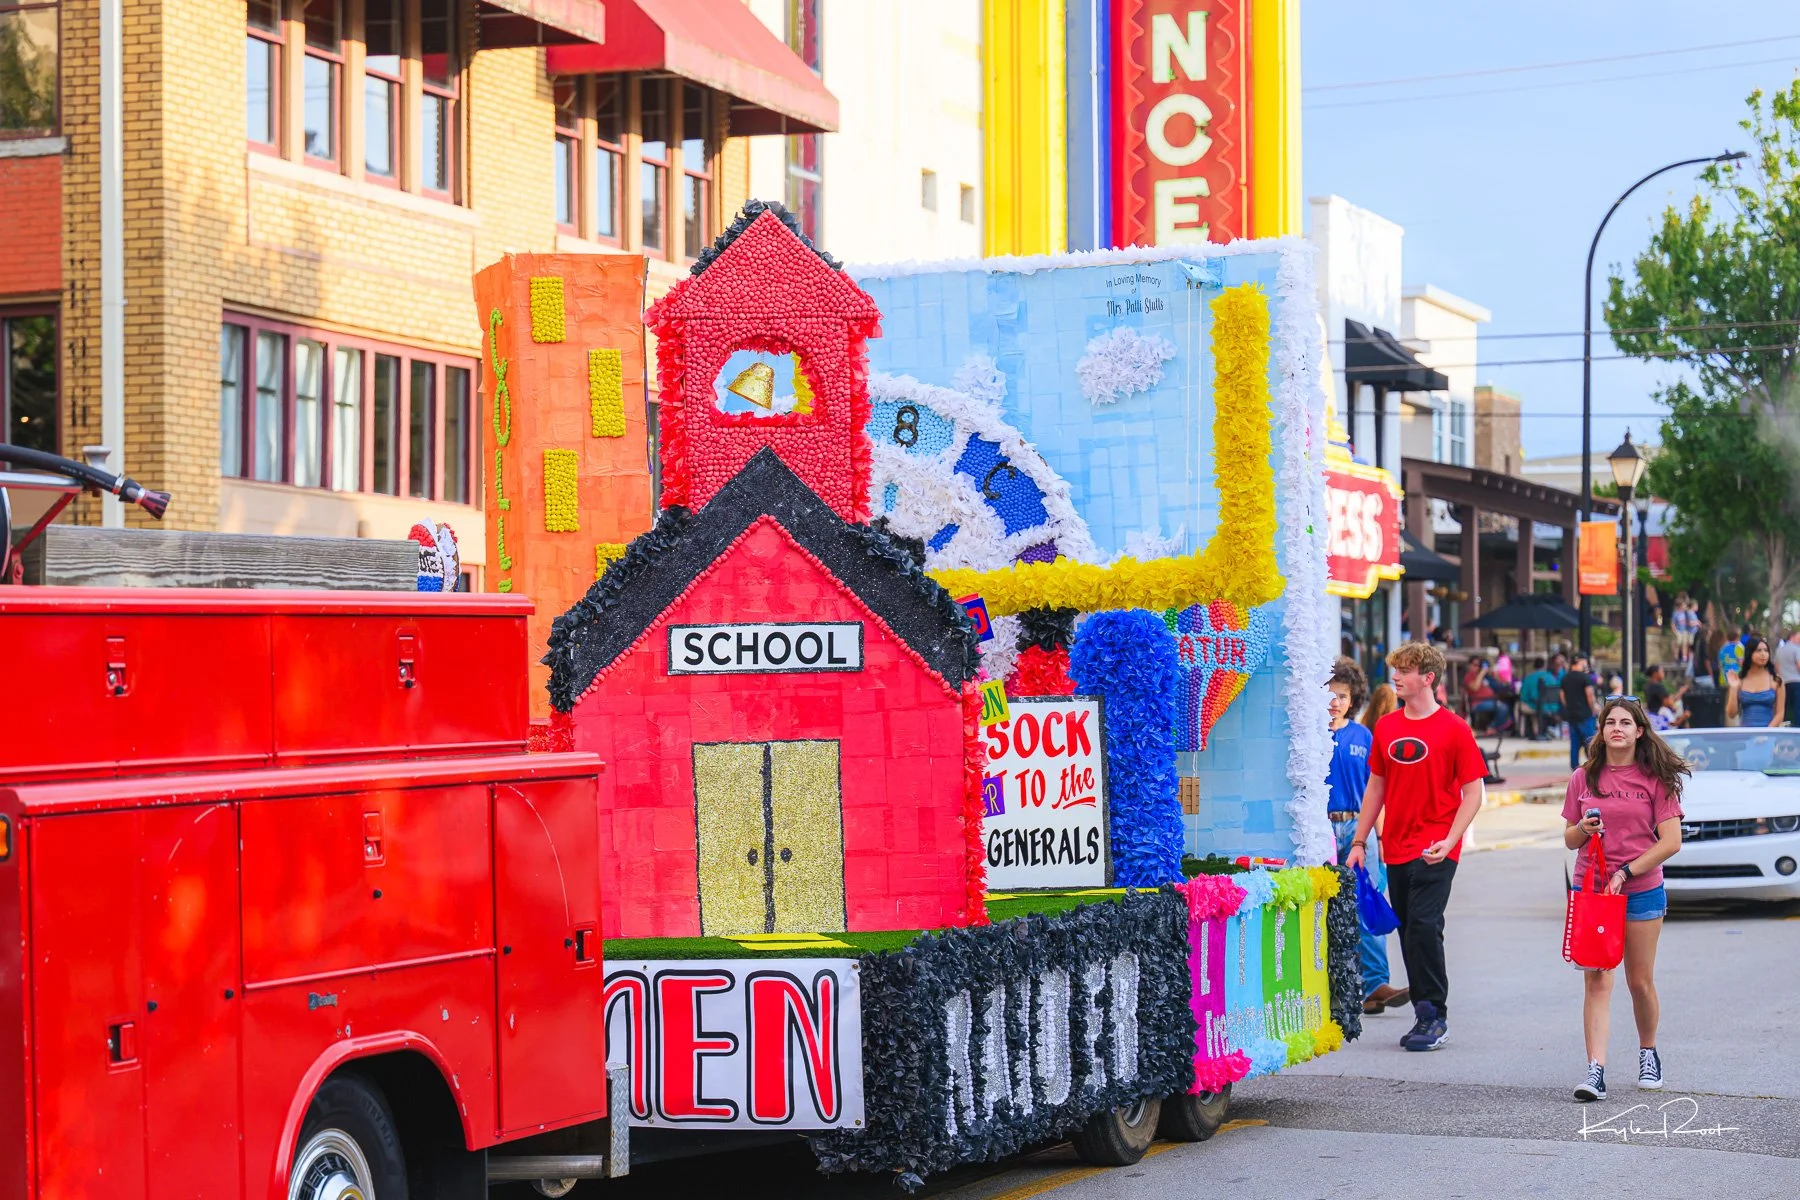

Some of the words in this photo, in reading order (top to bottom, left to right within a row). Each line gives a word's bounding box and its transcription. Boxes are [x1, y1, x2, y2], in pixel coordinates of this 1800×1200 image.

[1105, 279, 1113, 288] In
[1113, 274, 1135, 287] Loving
[1135, 273, 1162, 288] Memory
[1131, 287, 1137, 295] of
[1106, 300, 1122, 317] Mrs
[893, 405, 920, 448] 8
[489, 307, 512, 592] COLL
[1326, 485, 1384, 563] ESS
[683, 631, 847, 666] SCHOOL
[1174, 635, 1247, 666] ATUR
[986, 709, 1092, 760] SOCK
[1015, 768, 1046, 808] TO
[1051, 763, 1095, 810] the
[1581, 789, 1645, 799] DATUR
[986, 826, 1100, 868] GENERALS
